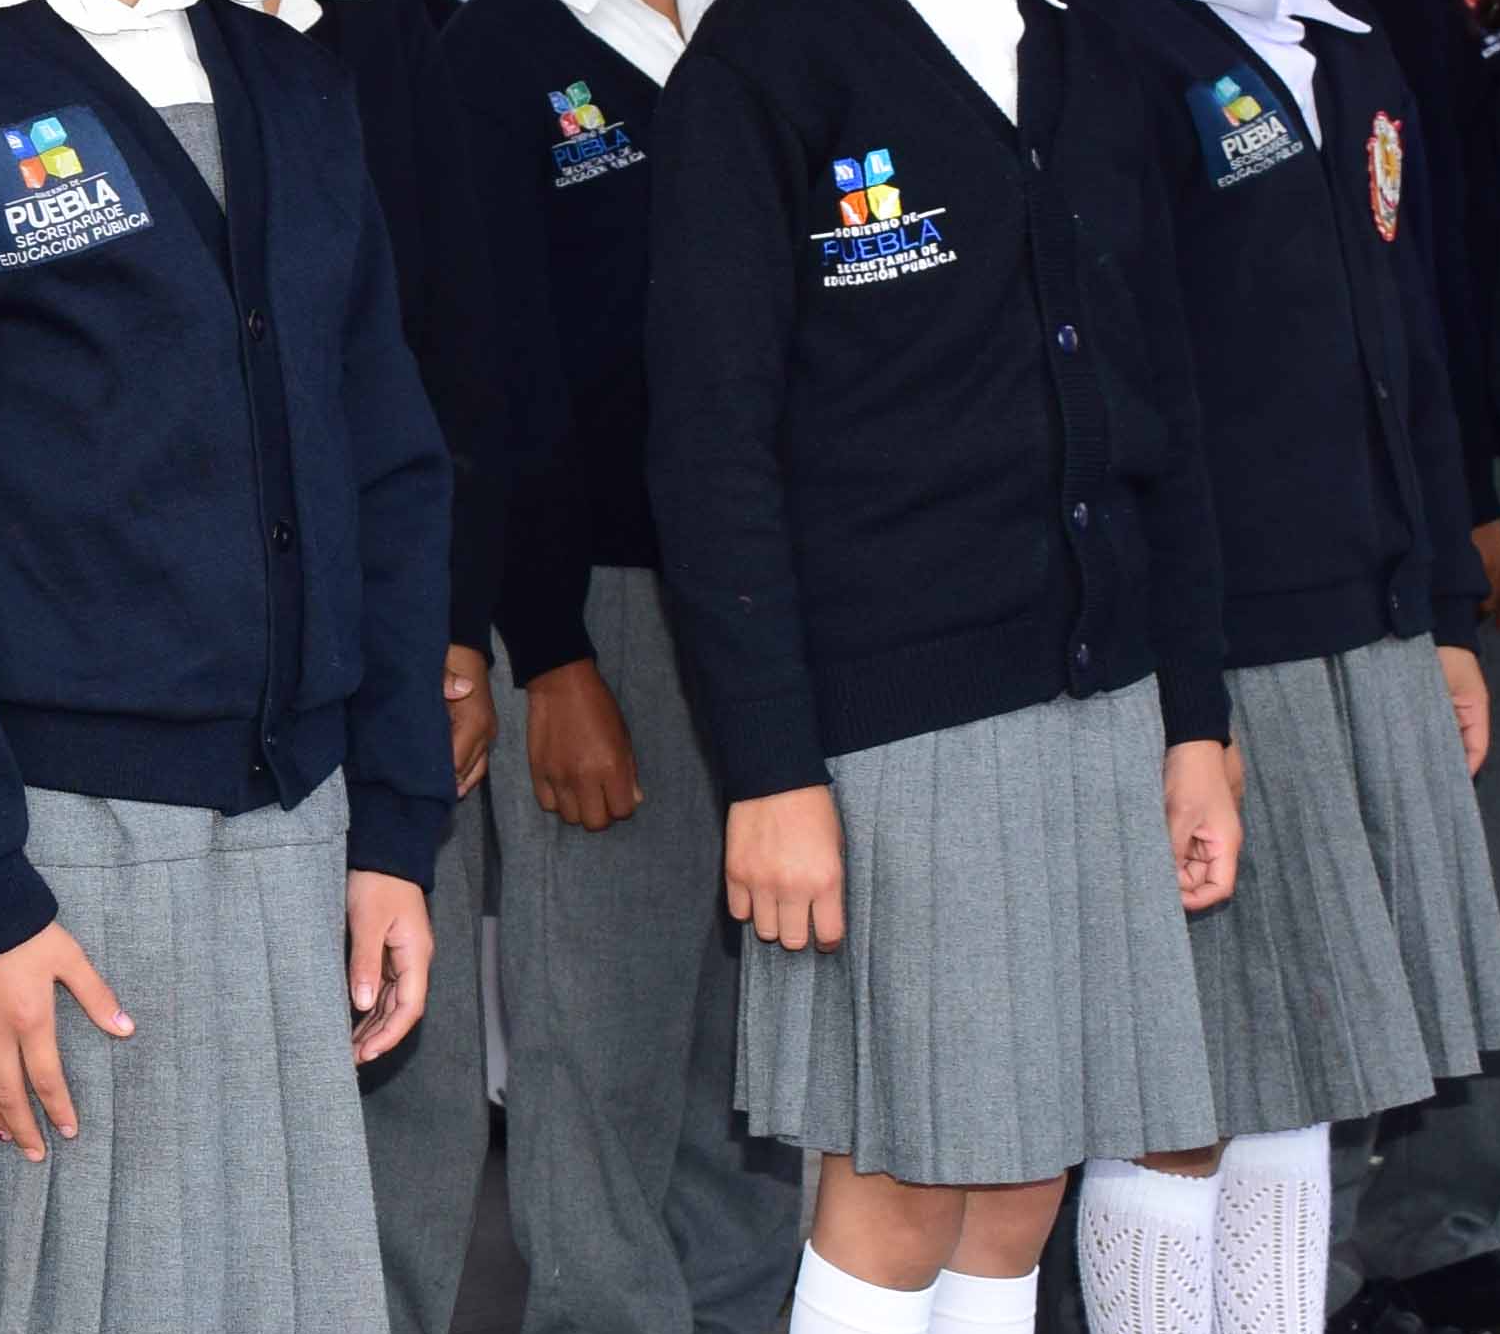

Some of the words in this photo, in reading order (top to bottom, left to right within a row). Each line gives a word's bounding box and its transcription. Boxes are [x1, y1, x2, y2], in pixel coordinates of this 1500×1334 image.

[553, 128, 632, 171] PUEBLA
[1221, 116, 1288, 161] PUEBLA
[5, 178, 121, 234] PUEBLA
[15, 209, 105, 249] SECRETARÍA
[104, 203, 125, 221] DE
[93, 211, 150, 241] PÚBLICA
[834, 218, 900, 238] GOBIERNO
[901, 211, 919, 226] DE
[823, 218, 942, 266] PUEBLA
[920, 242, 939, 257] DE
